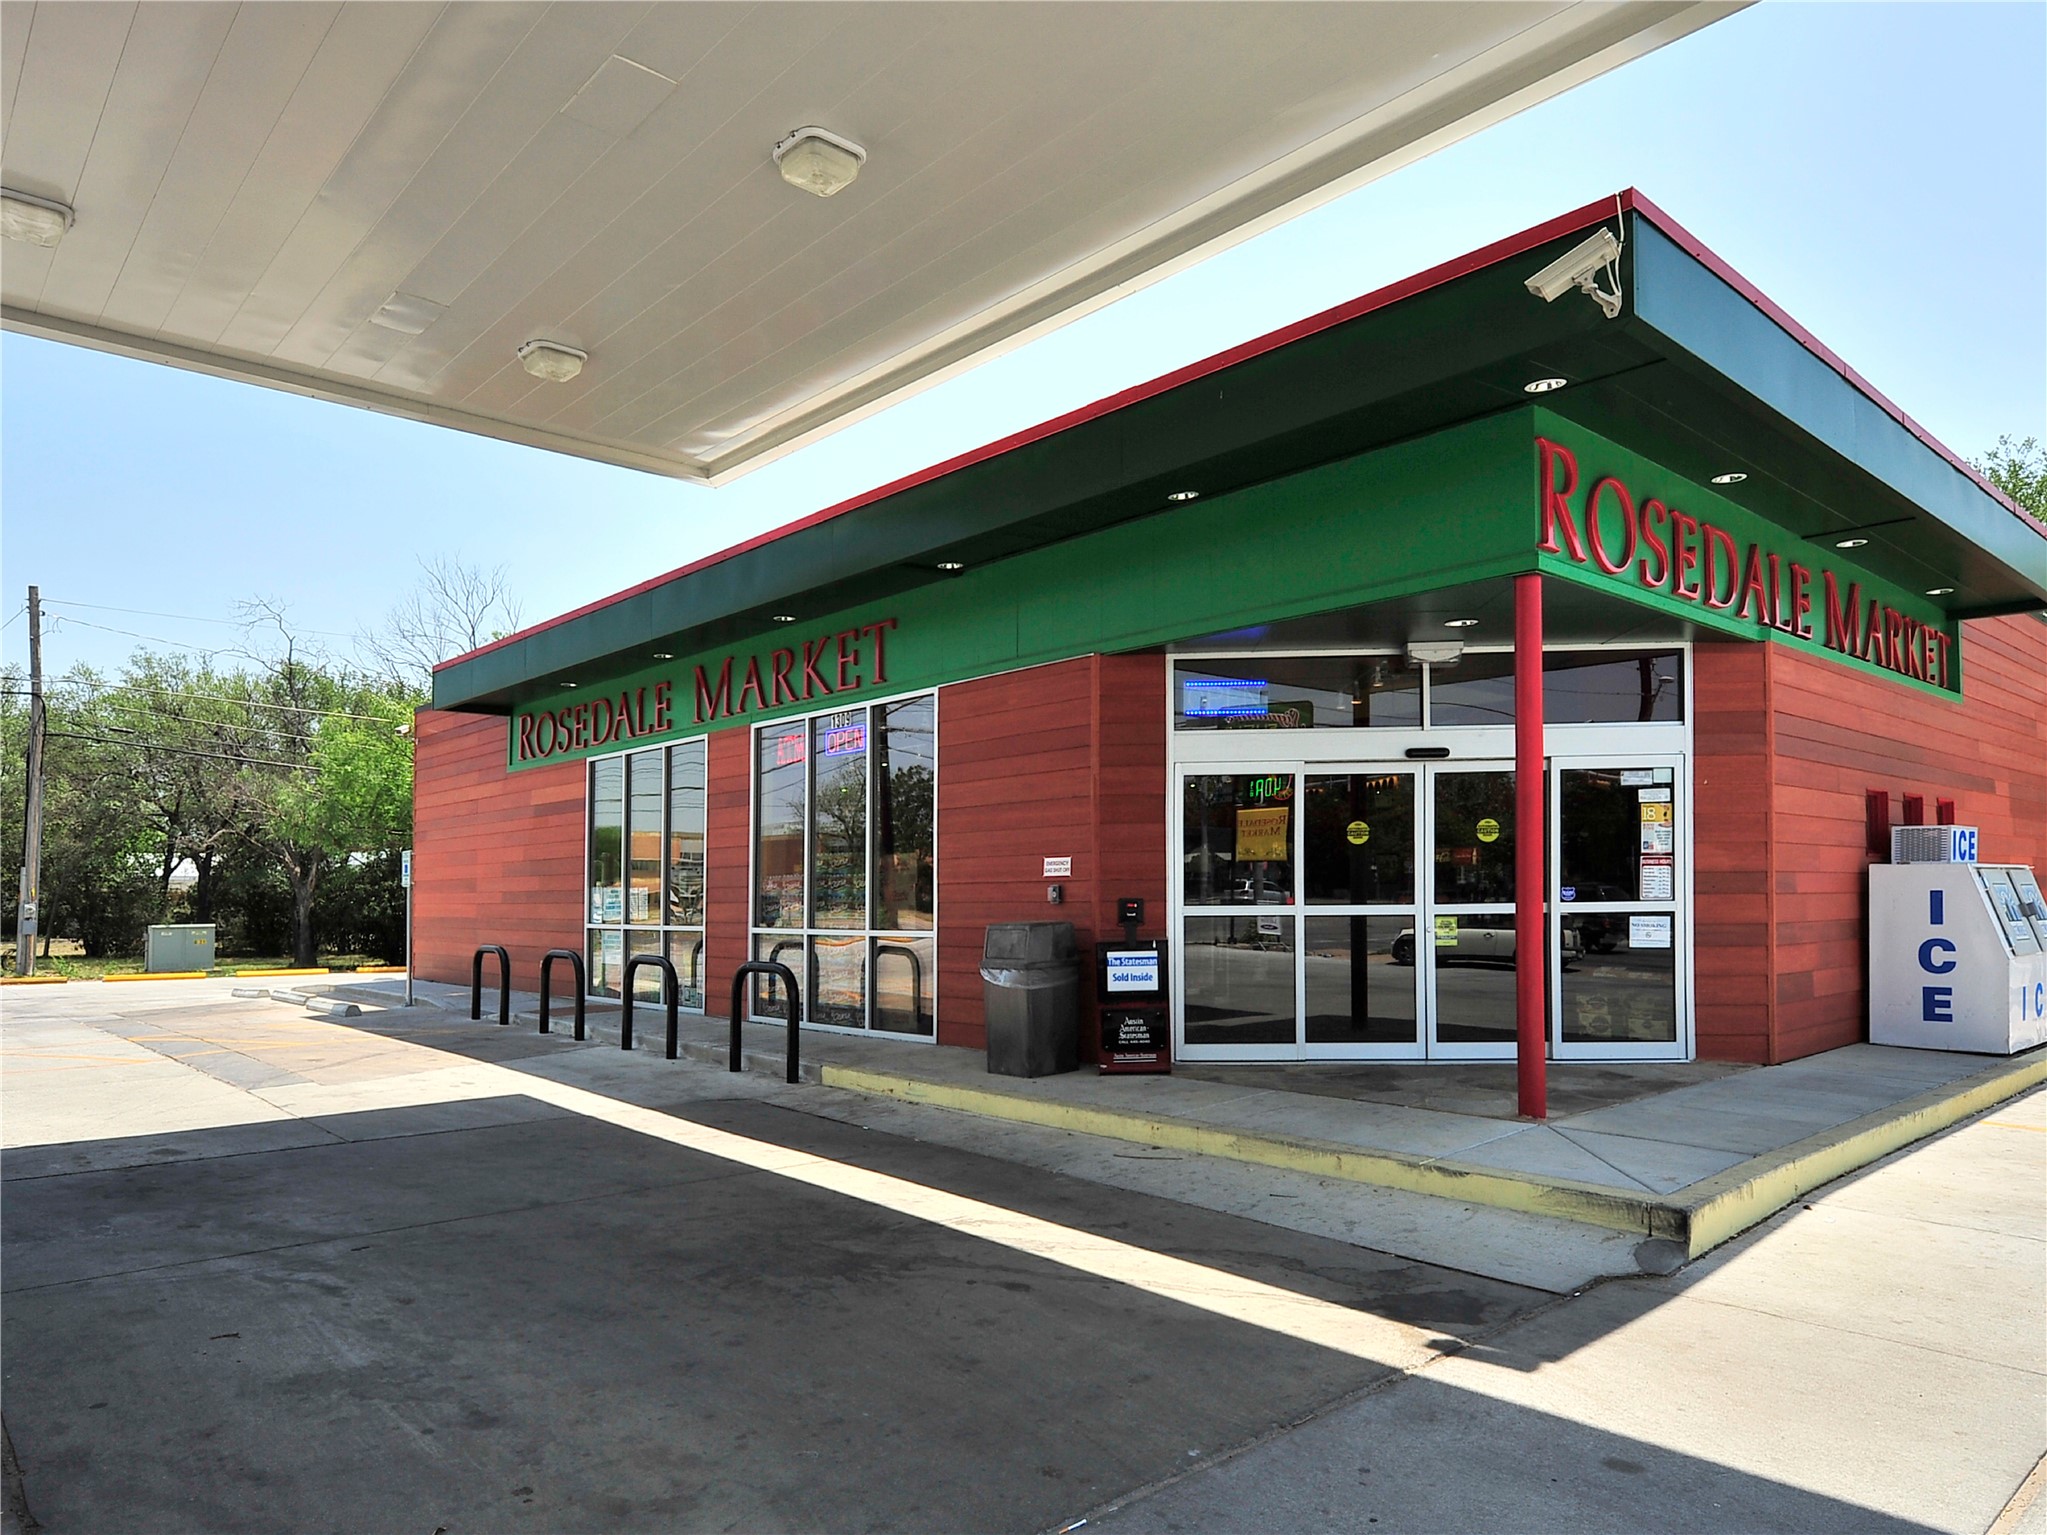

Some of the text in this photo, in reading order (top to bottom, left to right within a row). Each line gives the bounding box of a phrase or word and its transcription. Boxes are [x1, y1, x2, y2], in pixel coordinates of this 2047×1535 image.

[1535, 436, 1951, 689] ROSEDALE MARKET
[517, 618, 897, 761] ROSEDALE MARKET
[831, 712, 852, 729] 1309
[777, 735, 805, 764] ATM
[828, 728, 864, 753] OPEN
[1642, 807, 1656, 820] 18
[1952, 831, 1976, 861] ICE
[1108, 957, 1158, 966] The Statesman
[1917, 889, 1956, 1023] ICE
[1112, 972, 1154, 982] Sold Inside
[1123, 1016, 1144, 1025] Austin
[1118, 1031, 1151, 1039] Statesman
